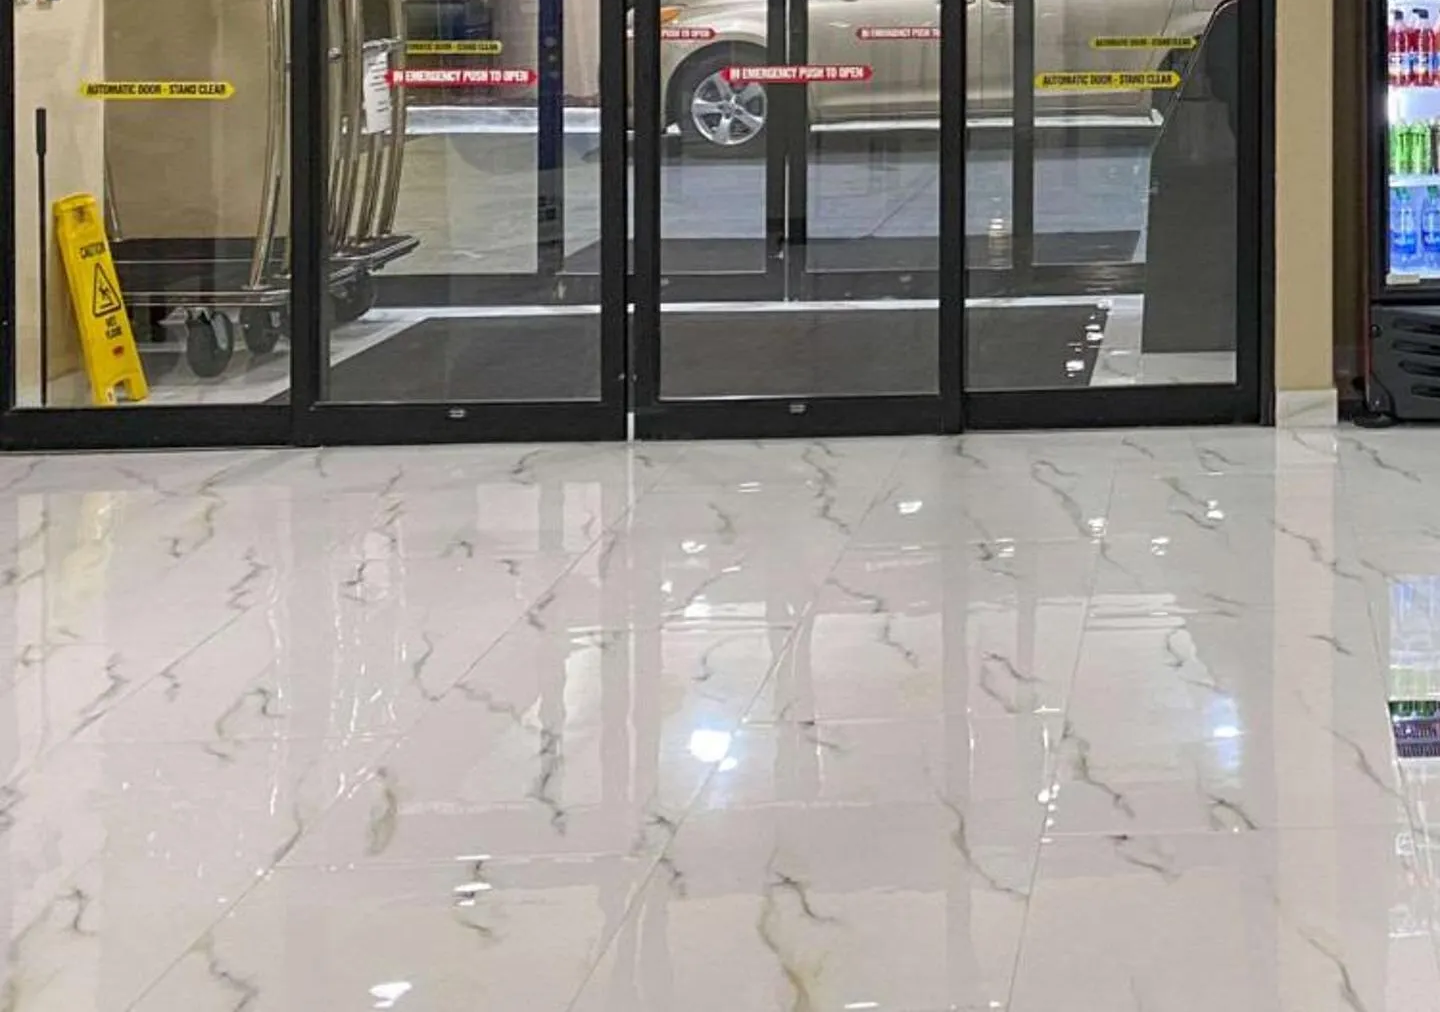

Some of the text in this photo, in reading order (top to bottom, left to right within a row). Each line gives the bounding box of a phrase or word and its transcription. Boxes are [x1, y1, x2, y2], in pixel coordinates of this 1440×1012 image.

[393, 70, 529, 82] IN EMERGENCY PUSH TO OPEN
[730, 67, 864, 80] IN EMERGENCY PUSH TO OPEN
[1043, 74, 1089, 85] AUTOMATIC
[1090, 74, 1112, 85] DOOR
[1119, 74, 1145, 85] STAND
[1147, 74, 1173, 85] CLEAR
[86, 84, 137, 95] AUTOMATIC
[138, 84, 161, 95] DOOR
[168, 84, 196, 95] STAND
[199, 84, 226, 95] CLEAR
[80, 242, 106, 259] CAUTION
